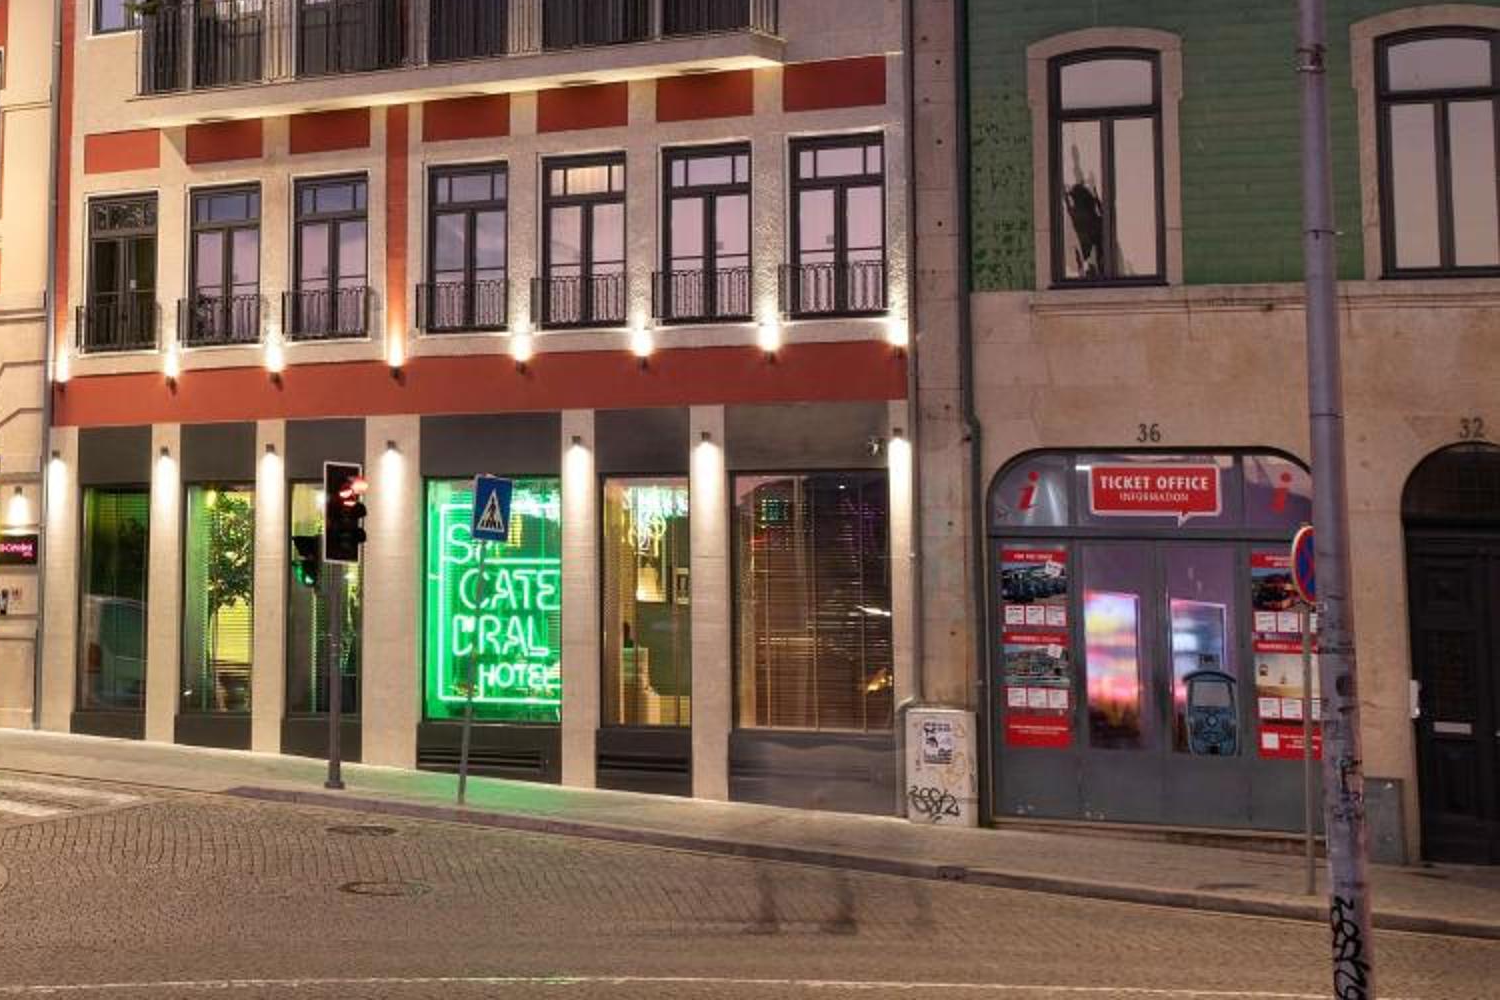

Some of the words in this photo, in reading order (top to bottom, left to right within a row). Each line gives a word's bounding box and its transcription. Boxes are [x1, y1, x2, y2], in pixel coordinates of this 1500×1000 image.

[1136, 423, 1161, 442] 36
[1099, 475, 1151, 490] TICKET
[1156, 476, 1210, 491] OFFICE
[1118, 491, 1189, 502] INFORMATION
[459, 567, 560, 611] CATE
[478, 662, 560, 691] HOTEL
